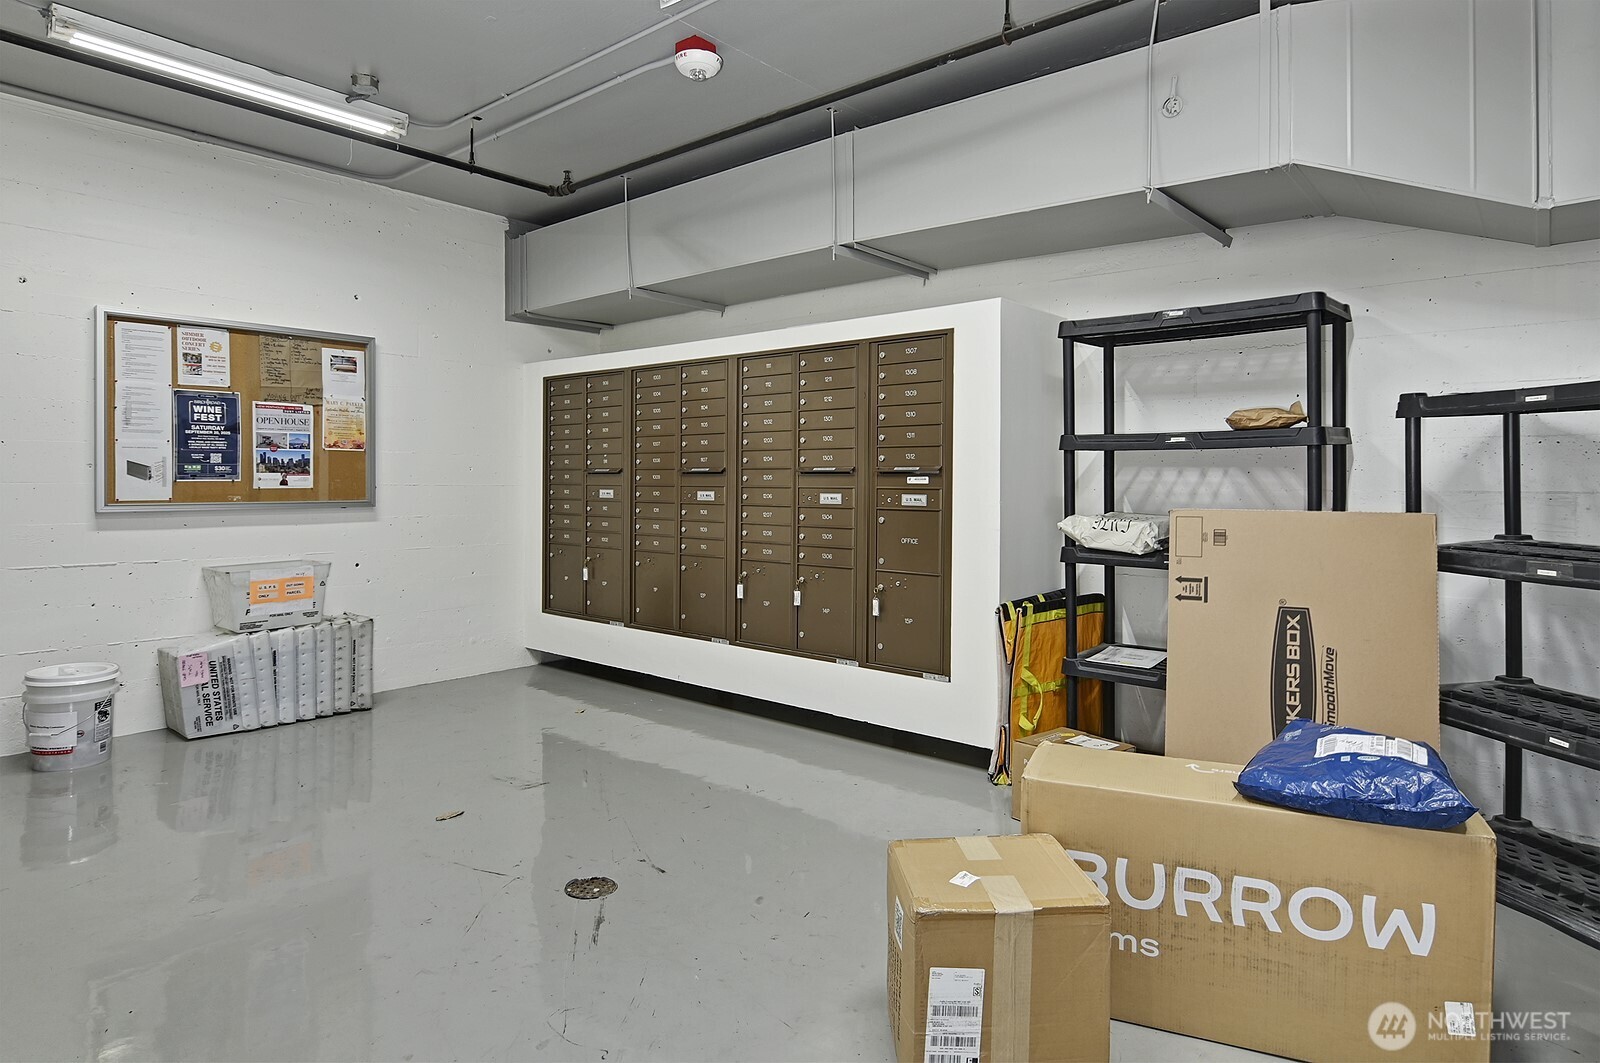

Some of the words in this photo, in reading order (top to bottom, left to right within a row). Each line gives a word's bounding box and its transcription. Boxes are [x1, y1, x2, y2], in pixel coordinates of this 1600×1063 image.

[676, 52, 688, 60] FIRE
[193, 405, 222, 413] WINE
[194, 413, 222, 421] FEST
[1286, 614, 1300, 659] BOX
[209, 661, 219, 689] UNITED
[202, 693, 213, 726] SERVICE
[213, 691, 223, 721] STATES
